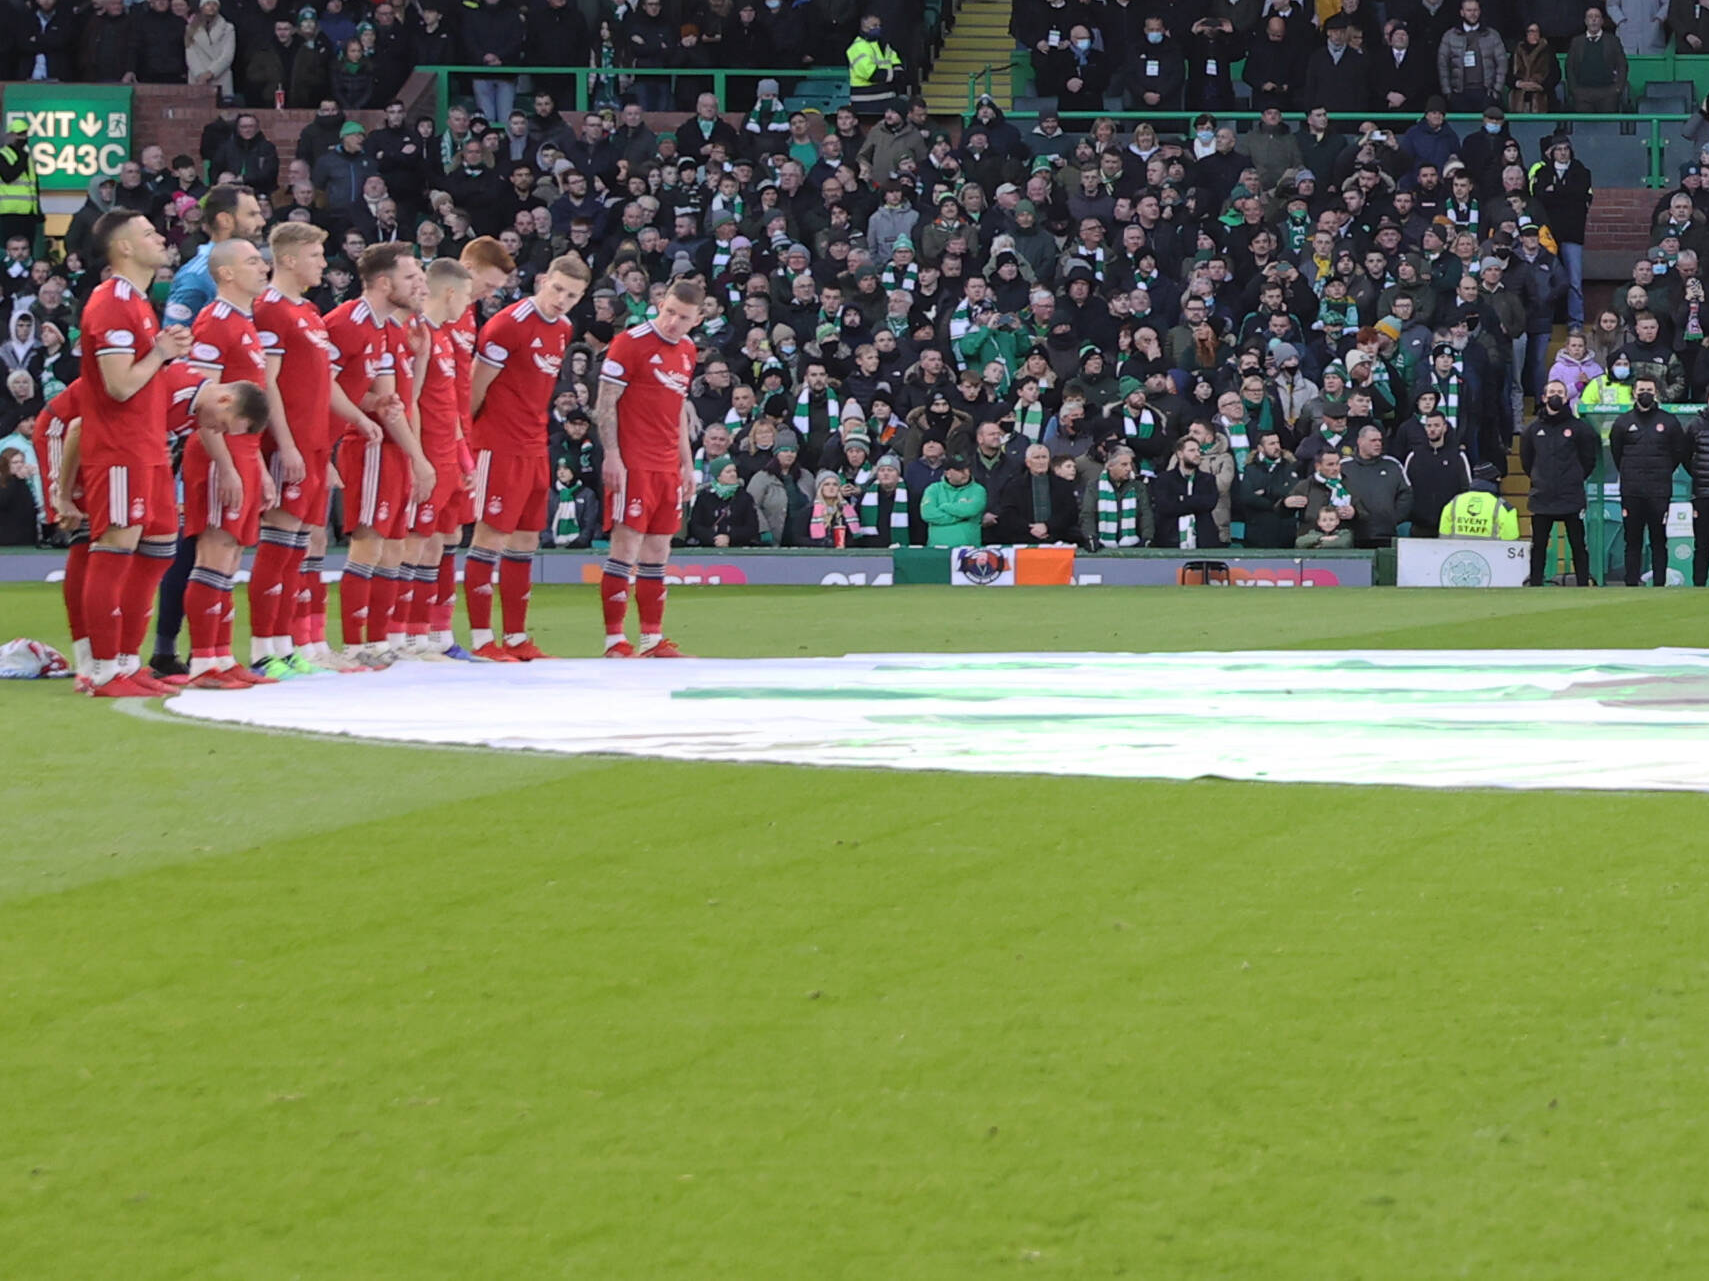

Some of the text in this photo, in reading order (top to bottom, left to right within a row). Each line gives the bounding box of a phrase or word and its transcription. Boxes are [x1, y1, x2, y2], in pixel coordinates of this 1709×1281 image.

[33, 141, 126, 176] S43C
[1457, 517, 1489, 526] EVENT
[1457, 524, 1488, 534] STAFF
[1507, 546, 1525, 560] S4
